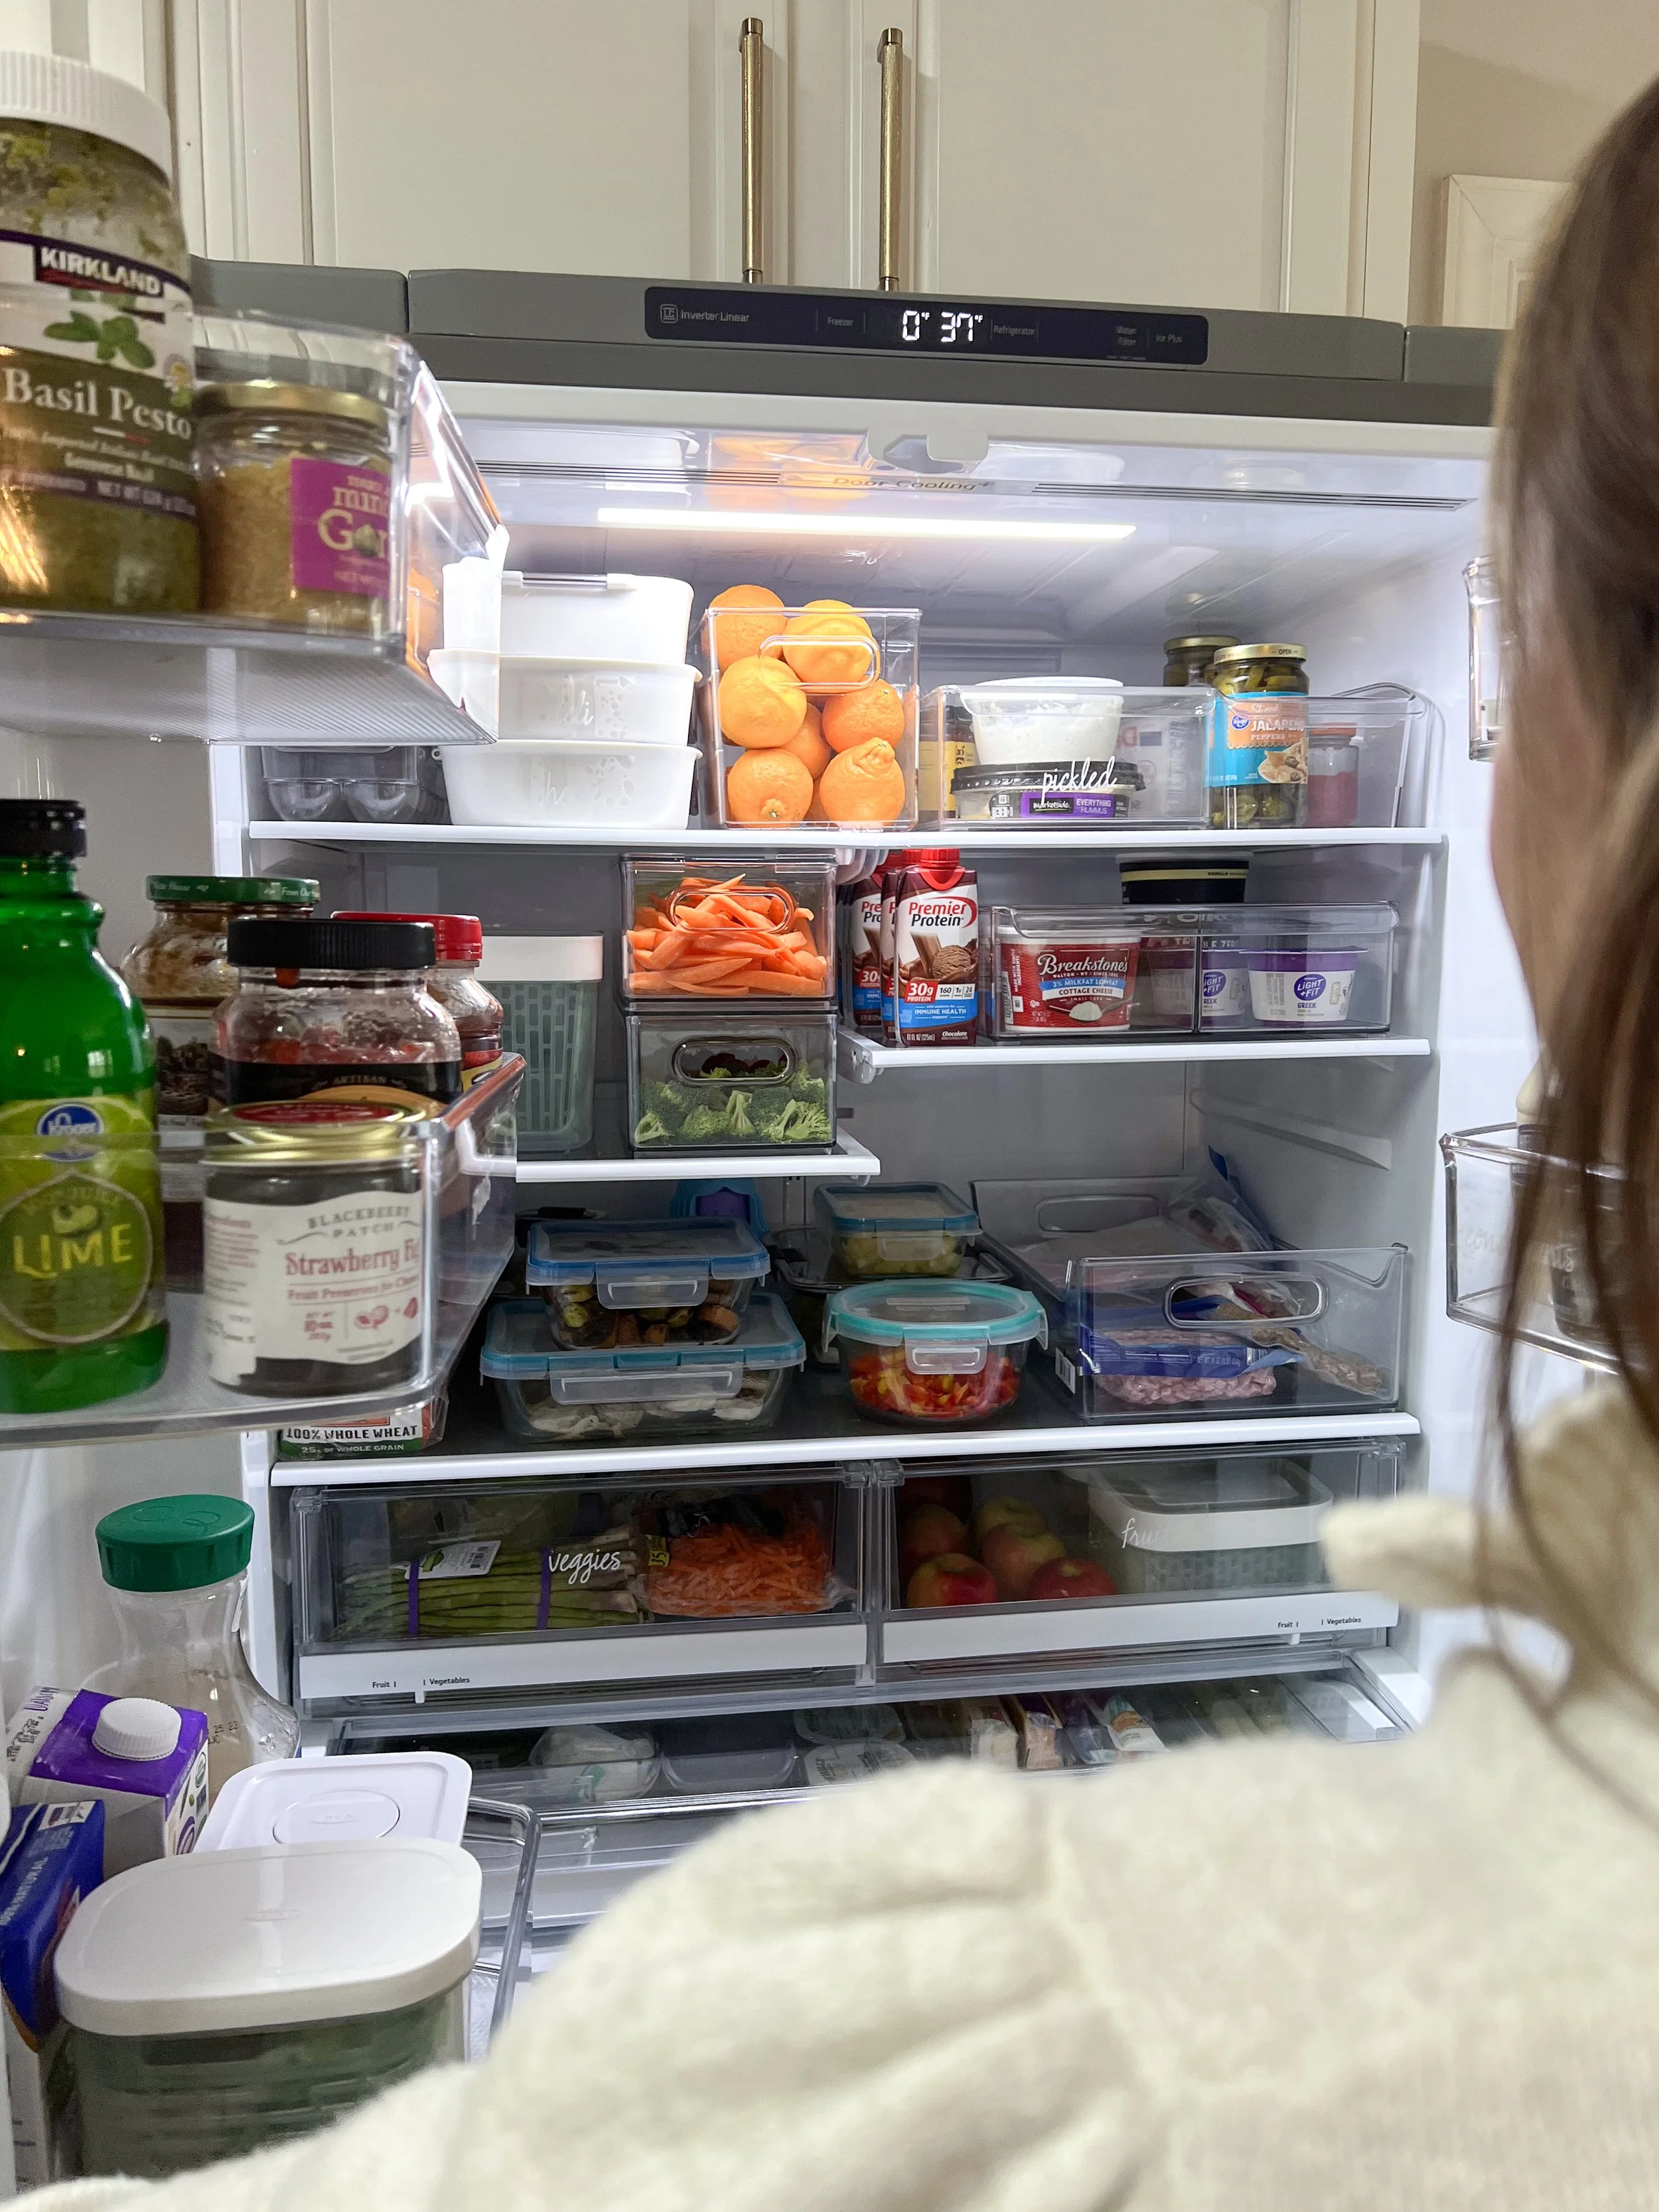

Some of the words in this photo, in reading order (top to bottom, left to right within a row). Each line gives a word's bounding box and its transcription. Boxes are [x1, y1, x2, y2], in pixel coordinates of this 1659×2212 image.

[40, 247, 162, 295] KIRKLAND
[681, 310, 719, 321] Inverter
[720, 312, 750, 323] Linear
[828, 316, 855, 327] Freezer
[993, 325, 1037, 337] Refrigerator
[1167, 334, 1183, 344] Plus
[3, 368, 99, 417] Basil
[109, 386, 192, 440] Pesto
[833, 477, 889, 487] Door
[1041, 755, 1118, 806] pickled
[1076, 798, 1112, 807] EVERYTHING
[908, 901, 967, 916] Premier
[910, 914, 961, 927] Protein
[1037, 953, 1128, 975] Breakstone's
[908, 982, 934, 997] 30g
[332, 1074, 388, 1085] ARTISAN
[332, 1223, 394, 1238] PATCH
[13, 1223, 133, 1280] LIME
[285, 1247, 400, 1276] Strawberry
[286, 1427, 321, 1440] 100%
[324, 1428, 370, 1440] WHOLE
[373, 1425, 418, 1438] WHEAT
[548, 1549, 621, 1585] veggies
[1327, 1616, 1362, 1626] Vegetables
[429, 1677, 470, 1686] Vegetables
